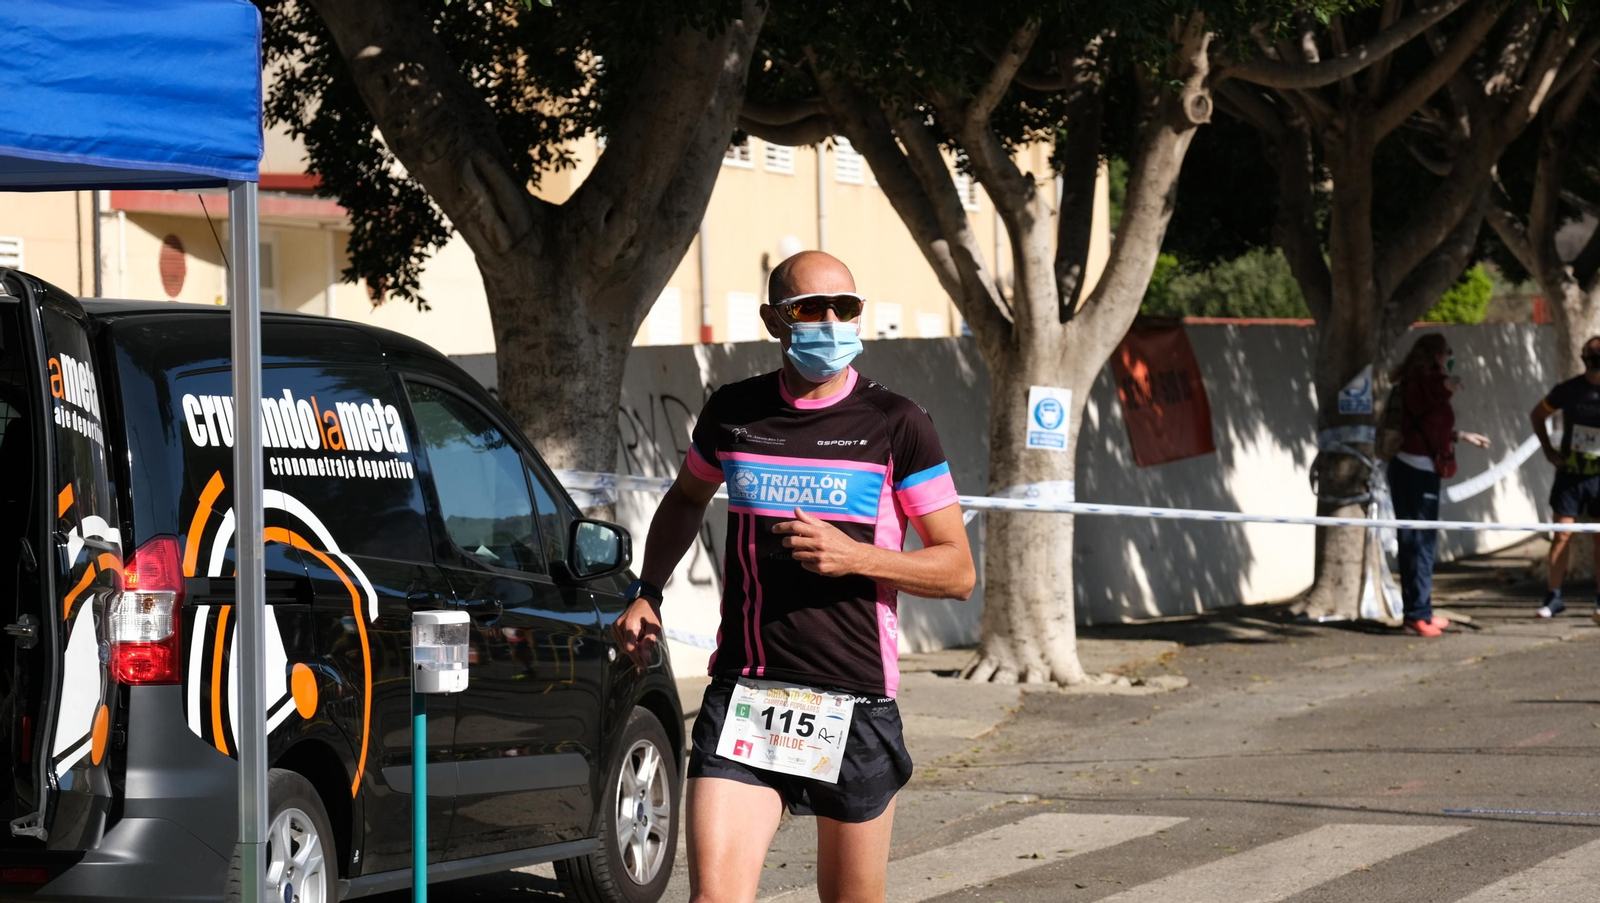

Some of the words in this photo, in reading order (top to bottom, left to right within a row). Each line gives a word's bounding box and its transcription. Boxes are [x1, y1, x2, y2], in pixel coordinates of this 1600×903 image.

[269, 456, 356, 479] cronometraje
[357, 456, 415, 480] deportivo
[760, 473, 847, 491] TRIATLÓN
[760, 485, 847, 506] INDALO
[789, 702, 820, 713] POPULARES
[761, 706, 816, 737] 115
[769, 733, 804, 751] TRIILDE
